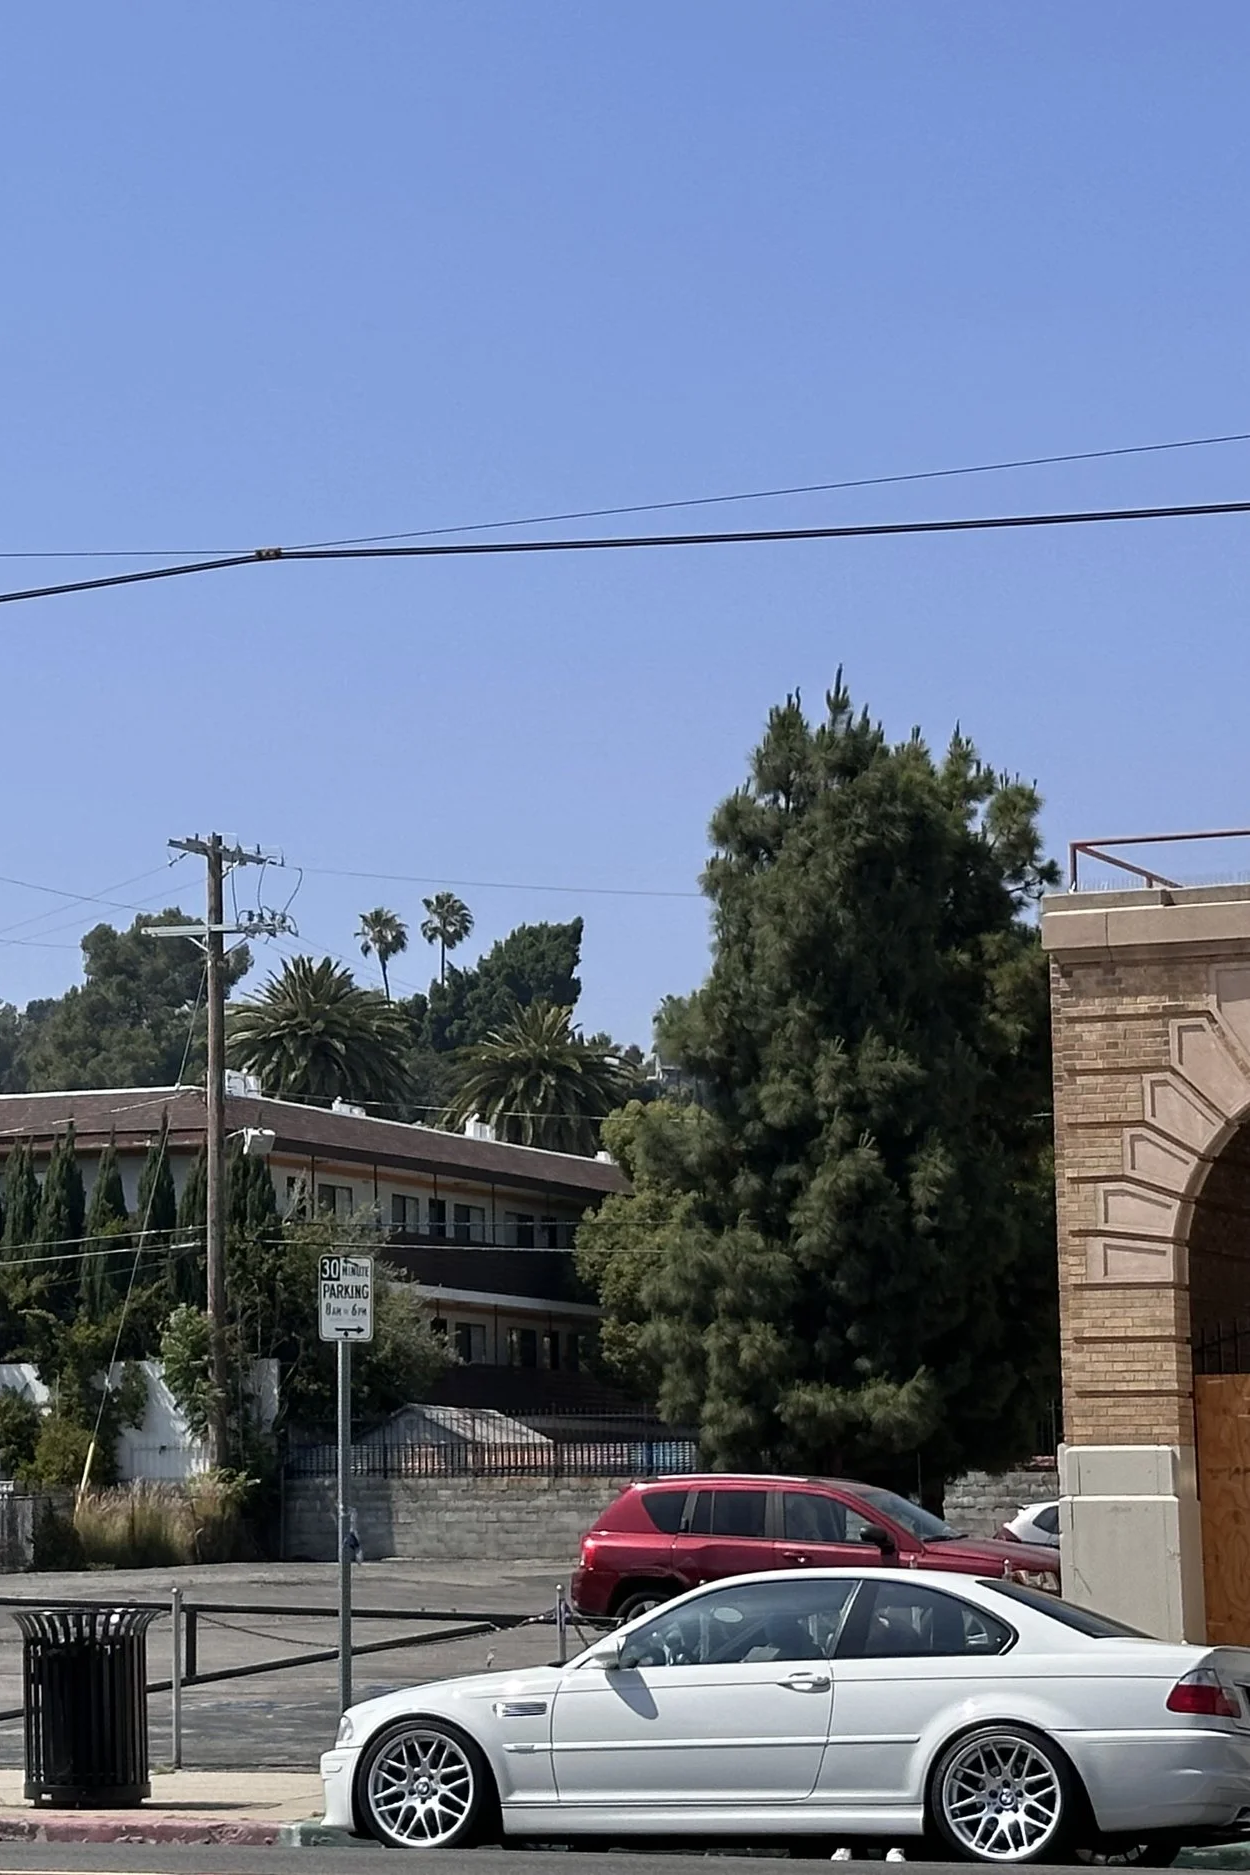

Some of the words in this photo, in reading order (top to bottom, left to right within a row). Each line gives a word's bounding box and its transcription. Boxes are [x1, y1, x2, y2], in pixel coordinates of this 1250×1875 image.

[321, 1258, 339, 1278] 30
[342, 1265, 369, 1277] MINUTE
[323, 1283, 369, 1299] PARKING
